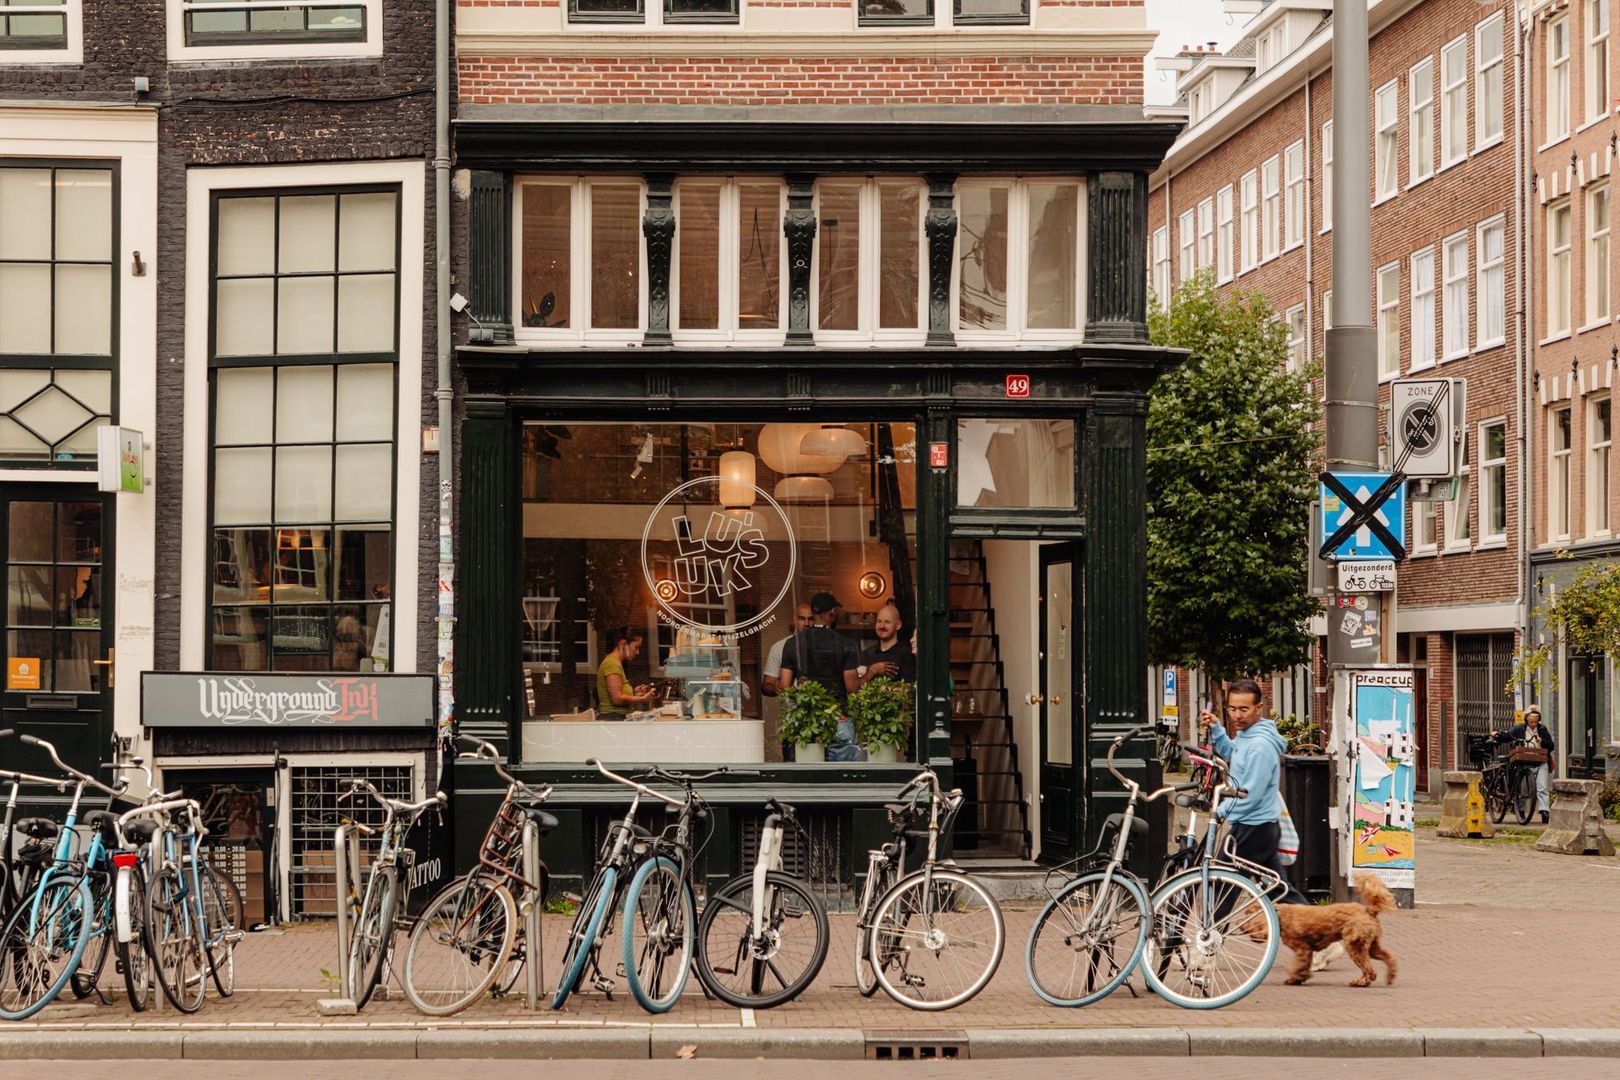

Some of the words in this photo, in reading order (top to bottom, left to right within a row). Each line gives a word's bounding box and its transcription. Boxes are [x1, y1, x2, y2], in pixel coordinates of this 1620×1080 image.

[1009, 379, 1027, 393] 49
[1407, 386, 1434, 397] ZONE
[674, 552, 752, 597] UK
[1342, 564, 1393, 574] Uitgezonderd
[723, 614, 778, 640] VIJZELGRACHT
[1166, 671, 1174, 686] P
[198, 678, 342, 725] Underground
